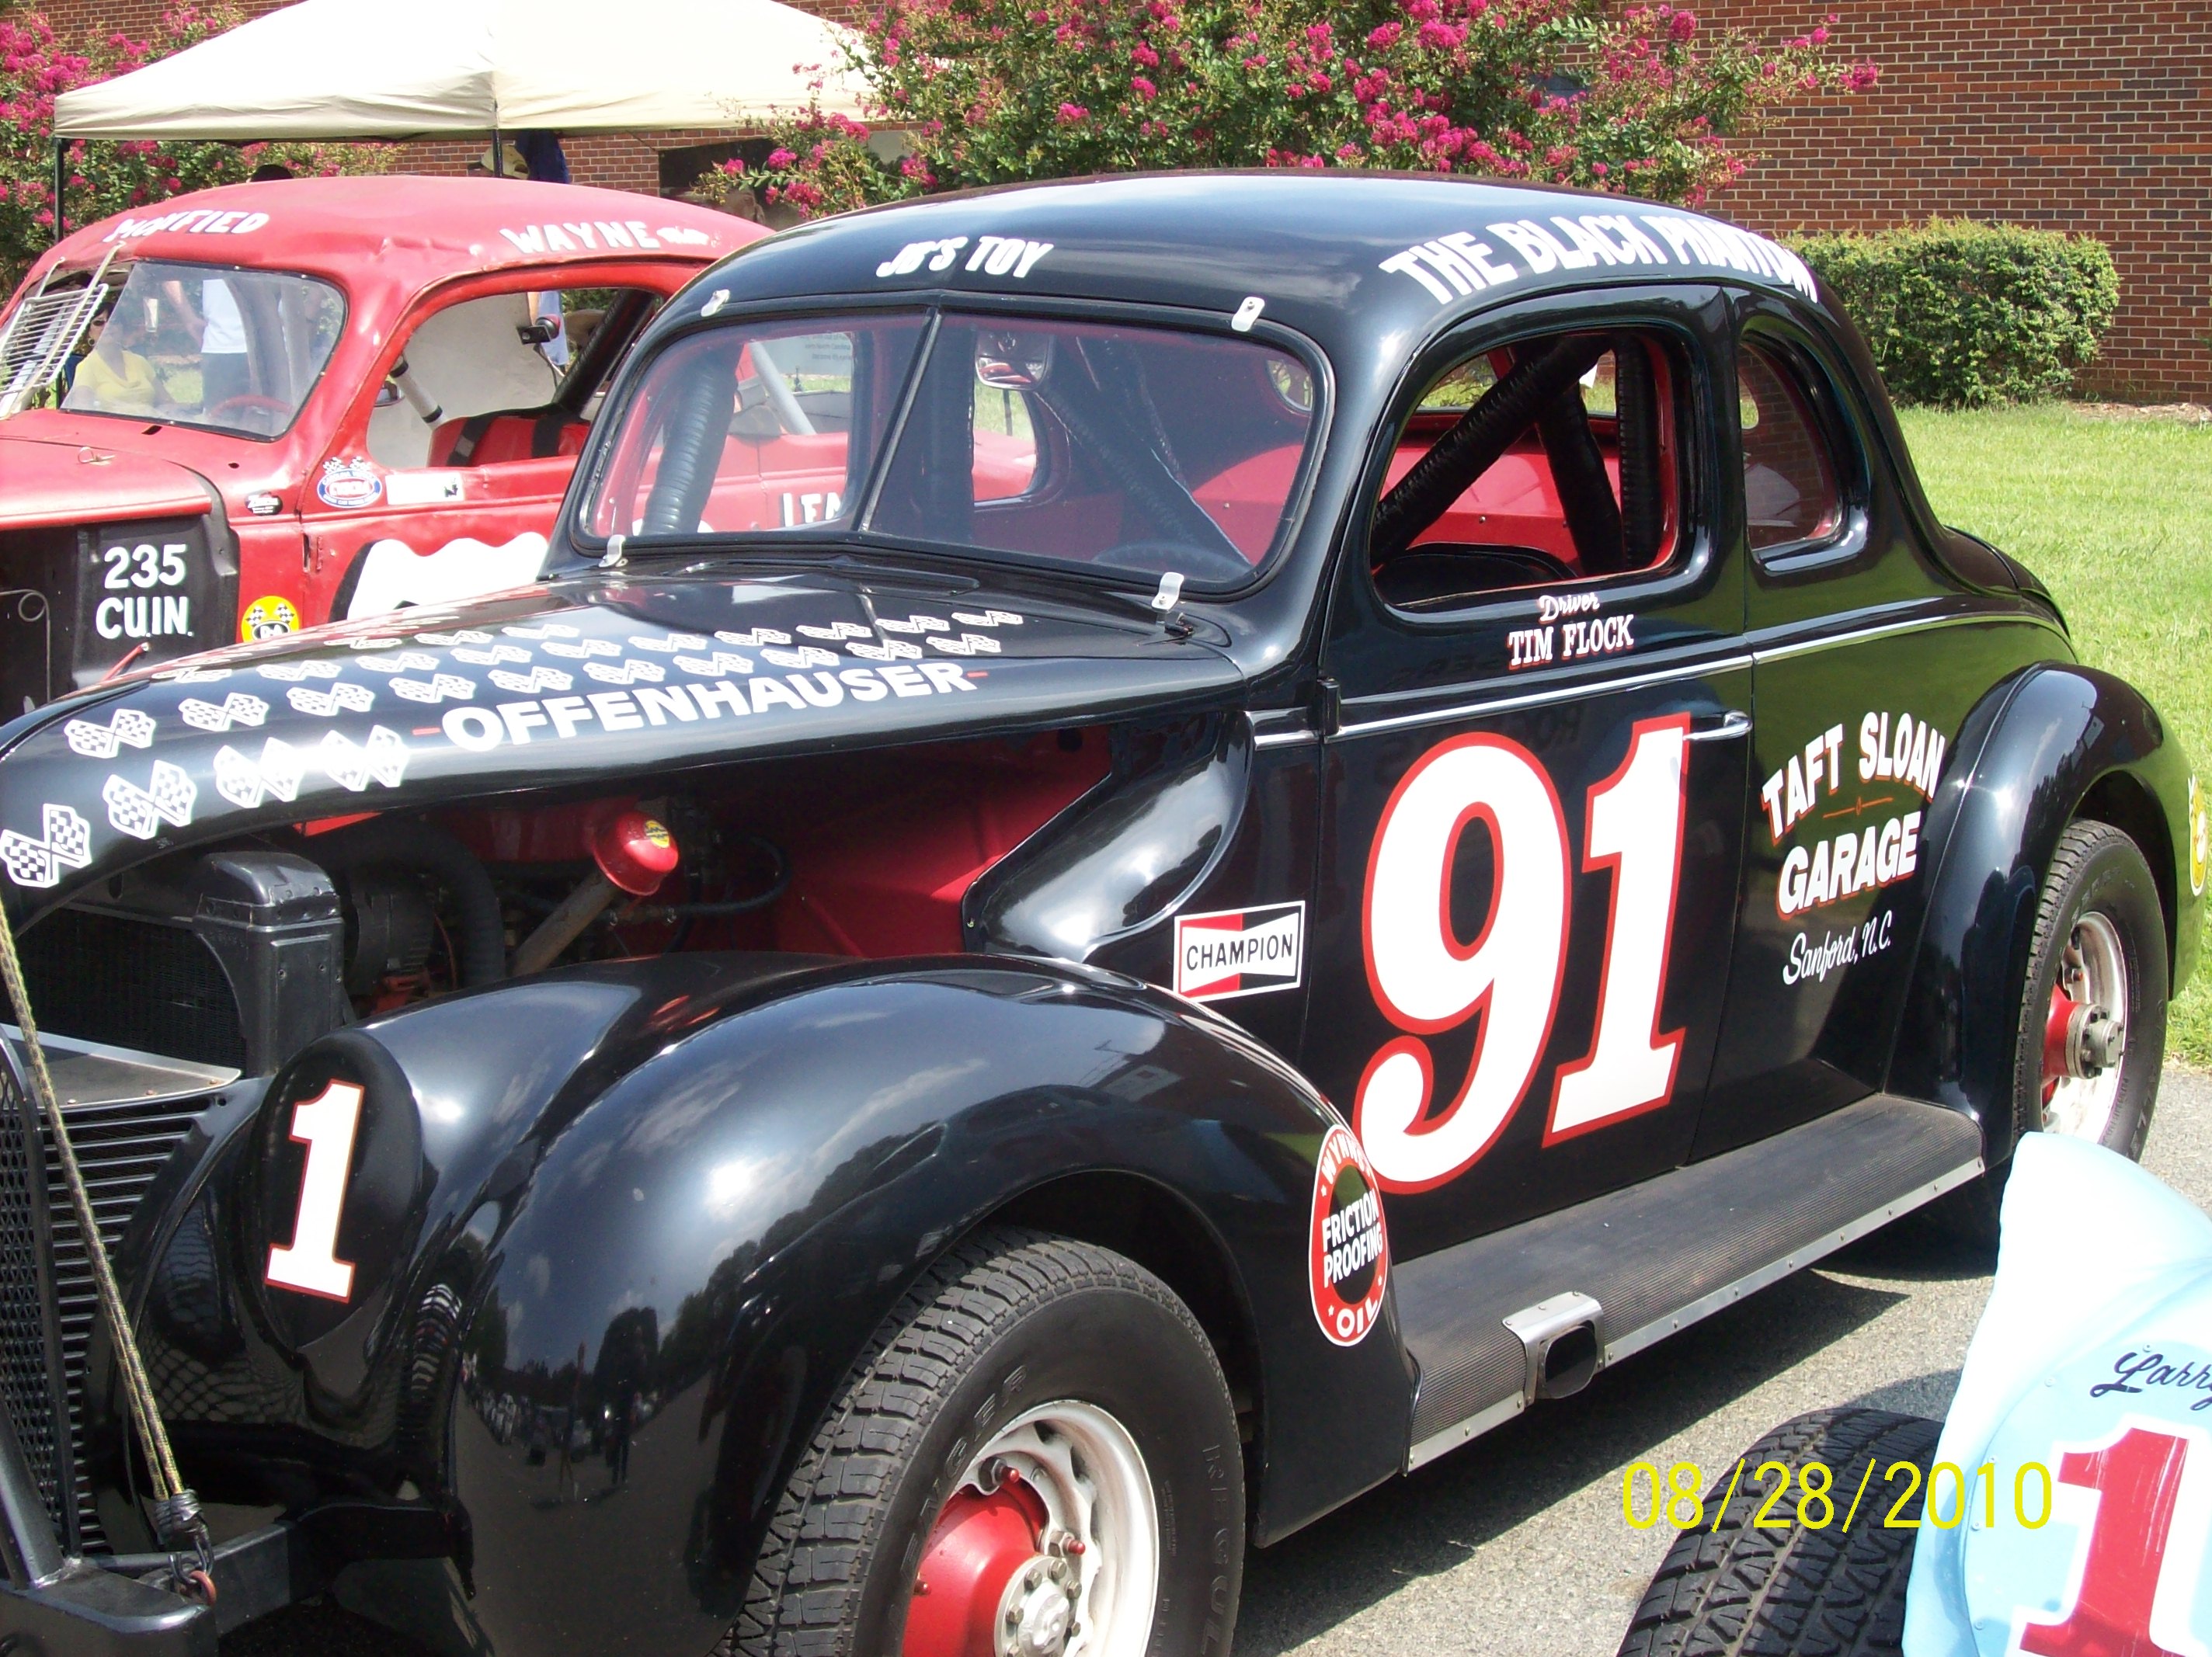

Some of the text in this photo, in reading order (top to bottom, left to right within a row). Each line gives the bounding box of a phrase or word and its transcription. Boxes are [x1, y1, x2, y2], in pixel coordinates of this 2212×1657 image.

[499, 221, 660, 254] WAYNE
[965, 235, 1055, 278] TOY
[1379, 214, 1819, 304] THE BLACK PHANTOM
[103, 544, 187, 589] 235
[1538, 590, 1600, 622] Driver
[1507, 613, 1634, 670] TIM FLOCK
[442, 662, 977, 752] OFFENHAUSER
[1761, 711, 1946, 846] TAFT SLOAN
[1776, 810, 1922, 921] GARAGE
[1185, 933, 1293, 972] CHAMPION
[1352, 712, 1692, 1195] 91
[1782, 932, 1859, 986] Sanford,
[264, 1078, 365, 1304] 1
[1322, 1188, 1379, 1252] FRICTION
[1323, 1221, 1383, 1289] PROOFING
[1336, 1297, 1379, 1338] OIL
